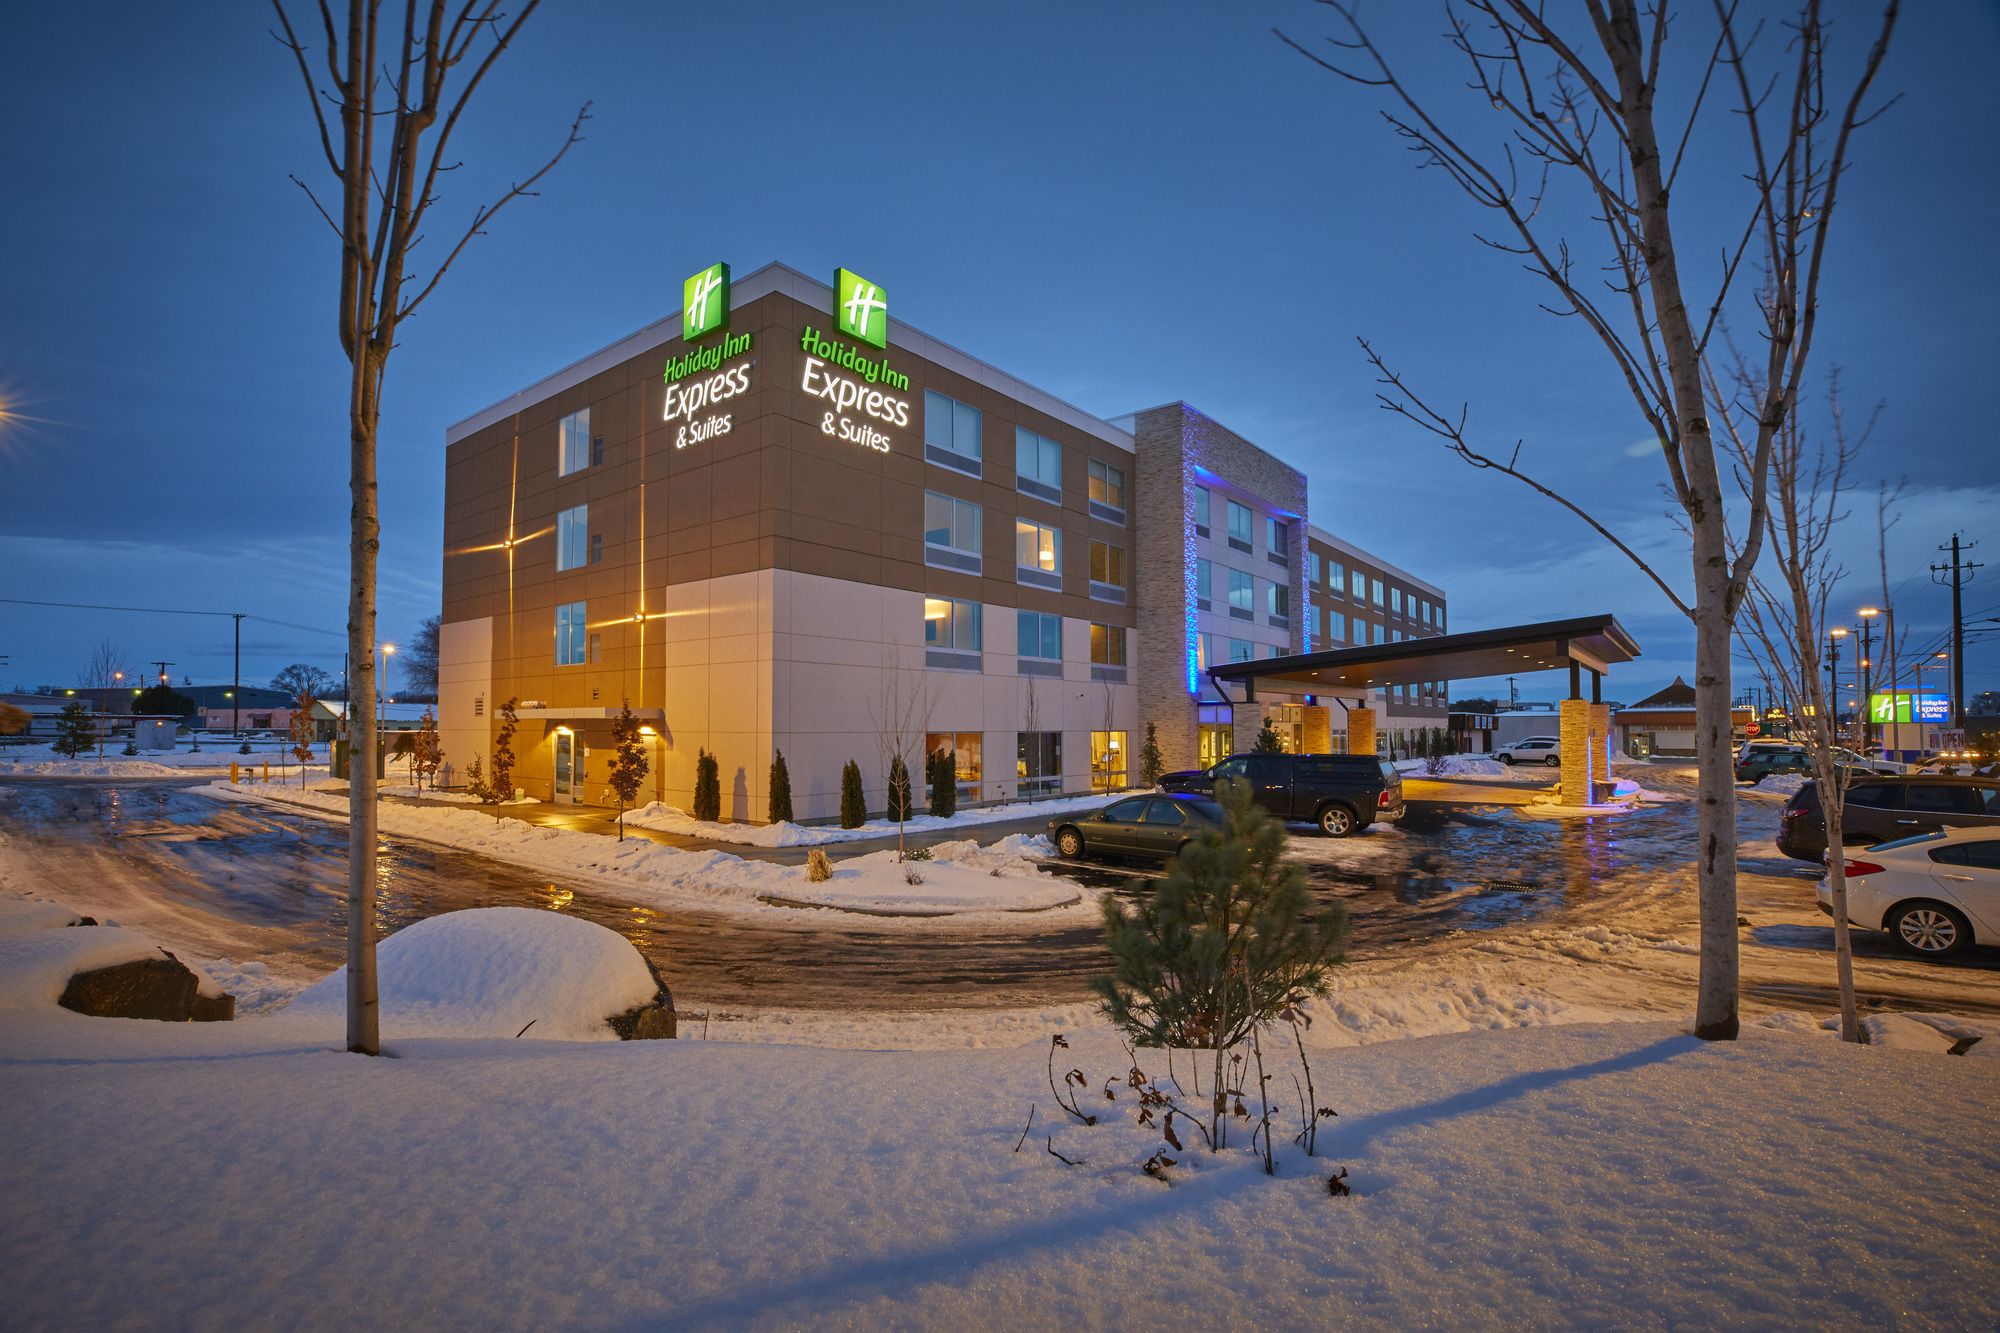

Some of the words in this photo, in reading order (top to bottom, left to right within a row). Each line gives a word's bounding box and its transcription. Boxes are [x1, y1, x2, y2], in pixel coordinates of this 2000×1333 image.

[663, 344, 722, 384] Holiday
[723, 332, 750, 360] Inn
[801, 325, 879, 384] Holiday
[881, 359, 909, 392] Inn
[663, 363, 751, 421] Express
[802, 356, 909, 428] Express
[676, 425, 687, 449] &
[688, 414, 732, 445] Suites
[821, 411, 836, 436] &
[838, 417, 891, 453] Suites
[1915, 705, 1948, 713] Express
